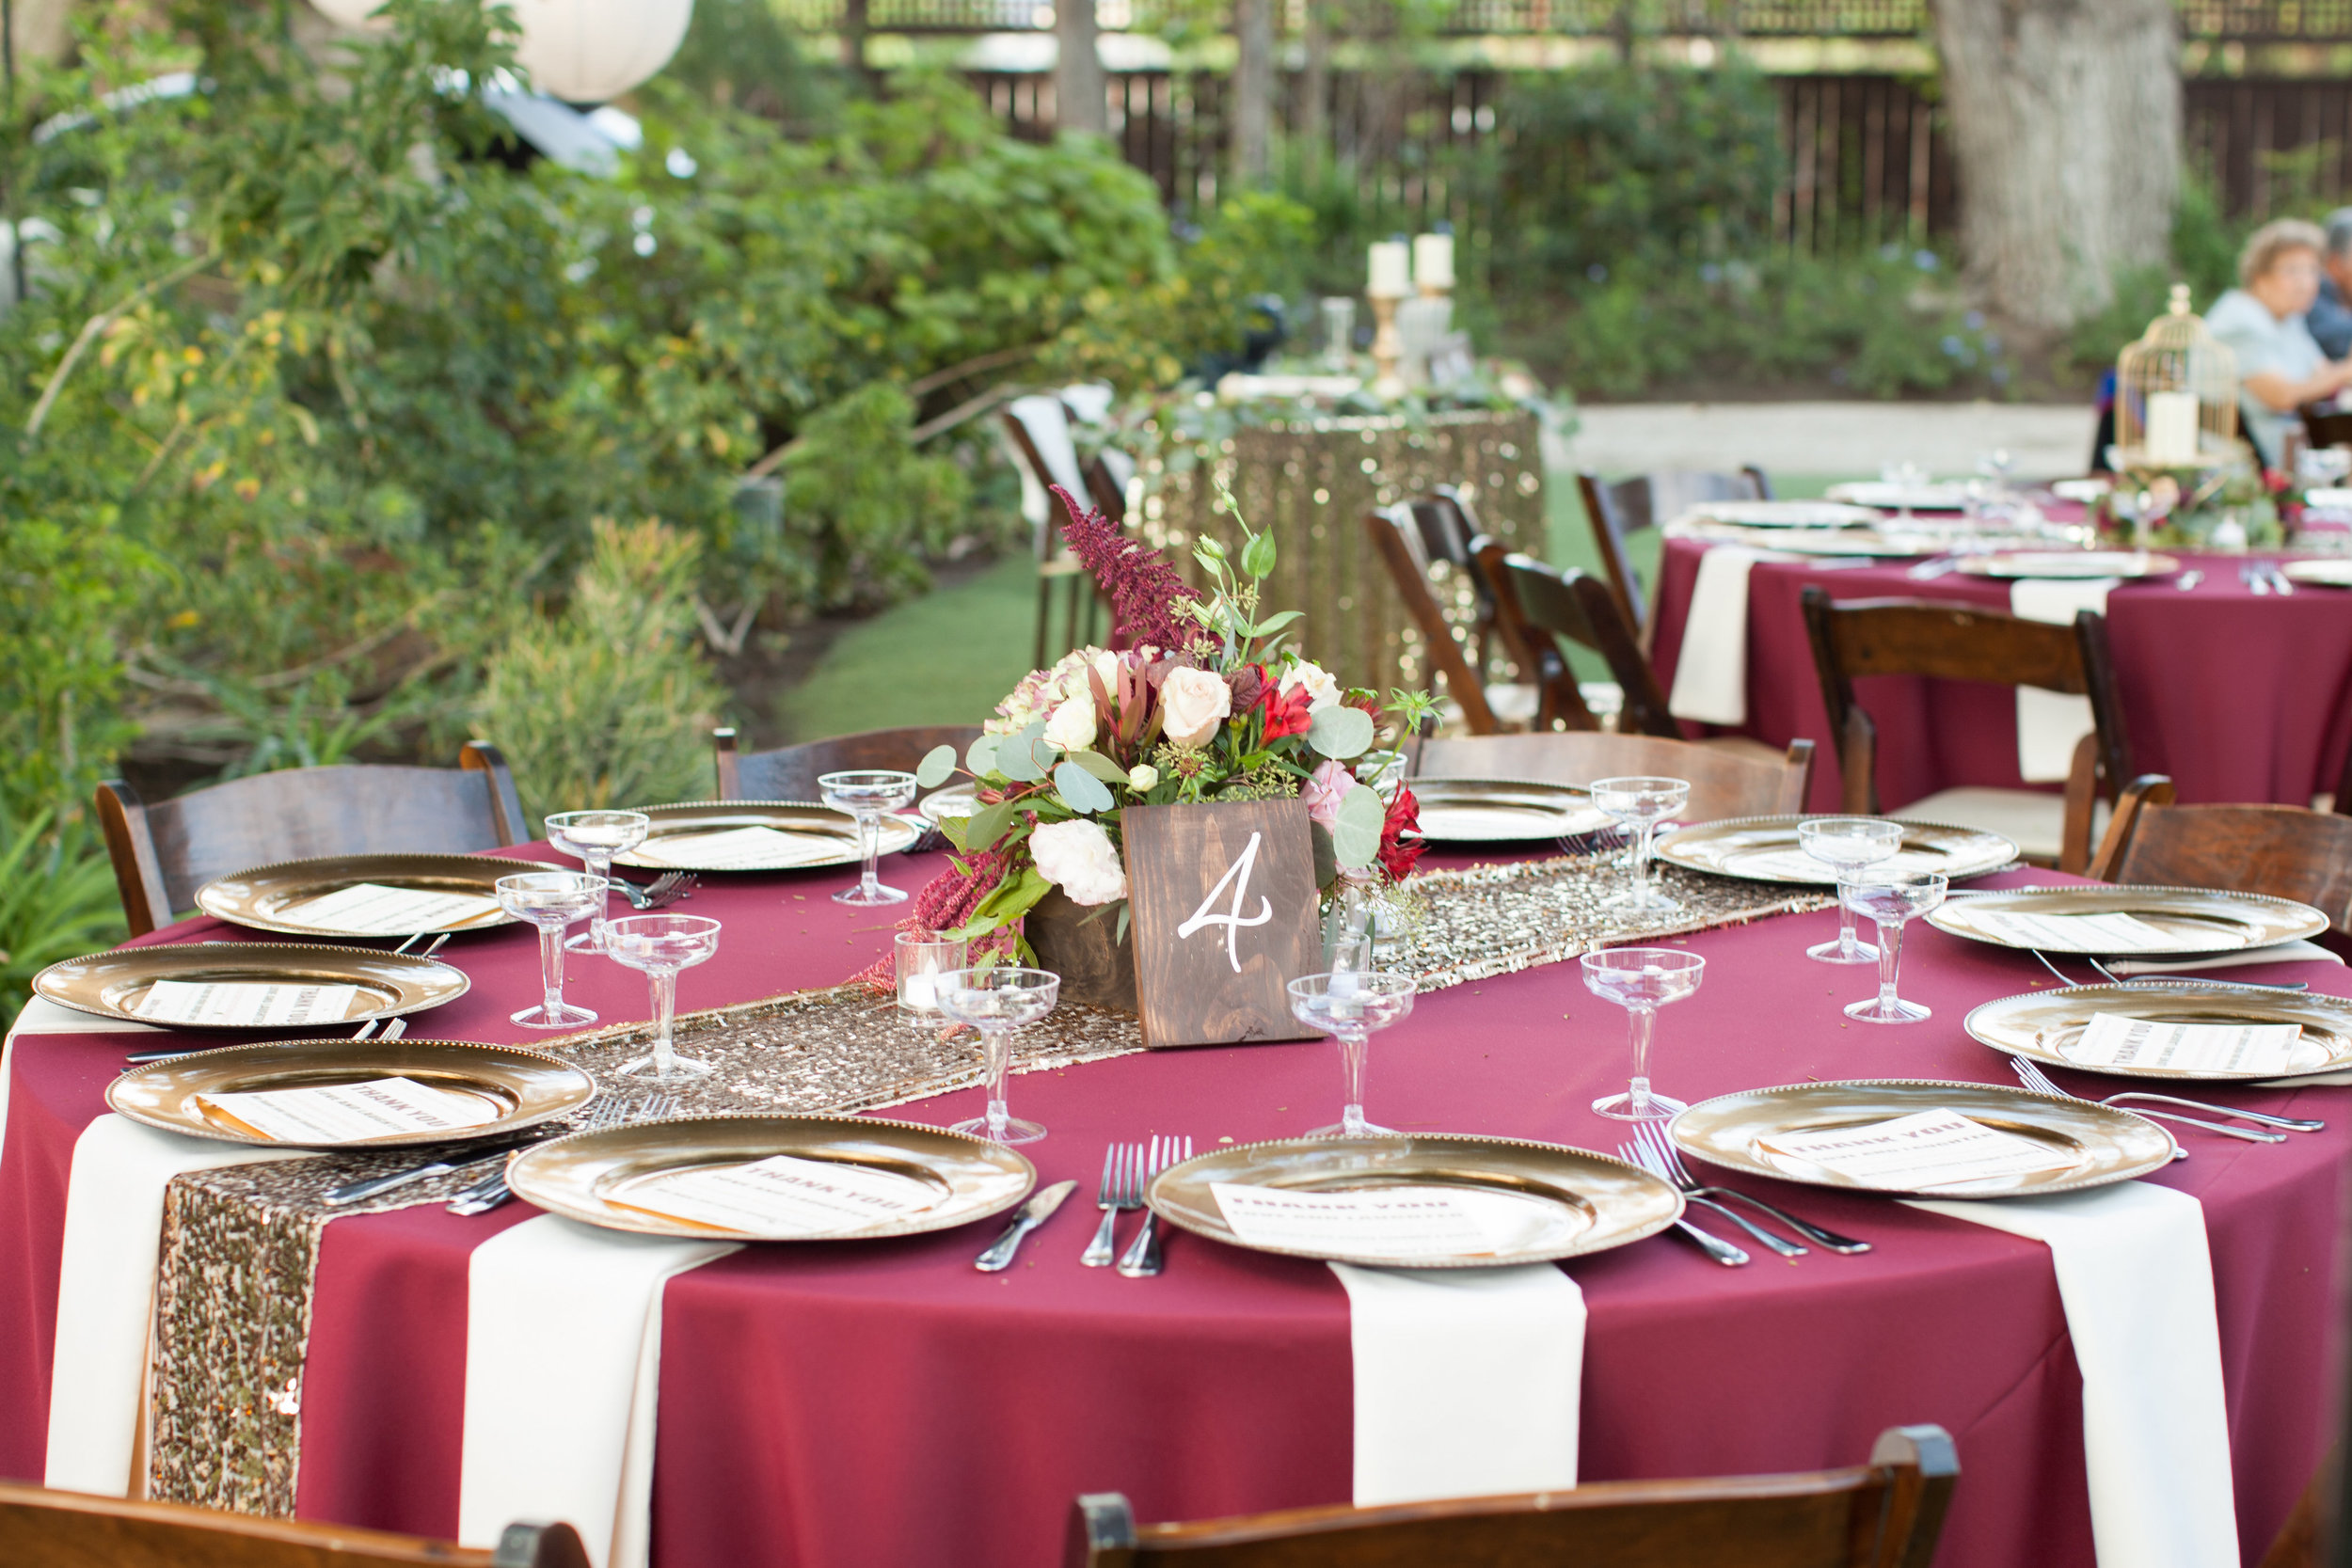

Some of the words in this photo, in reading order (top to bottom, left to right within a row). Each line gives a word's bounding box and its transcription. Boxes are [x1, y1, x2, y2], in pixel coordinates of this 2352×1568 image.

[1178, 832, 1273, 974] 4
[2111, 1037, 2145, 1064] THANK
[2128, 1022, 2153, 1037] YOU
[350, 1085, 415, 1112] THANK
[406, 1109, 451, 1128] YOU
[1792, 1135, 1897, 1153] THANK
[1901, 1121, 1966, 1139] YOU
[747, 1167, 842, 1194] THANK
[845, 1191, 905, 1210] YOU
[1229, 1196, 1357, 1211] THANK
[1372, 1199, 1450, 1210] YOU
